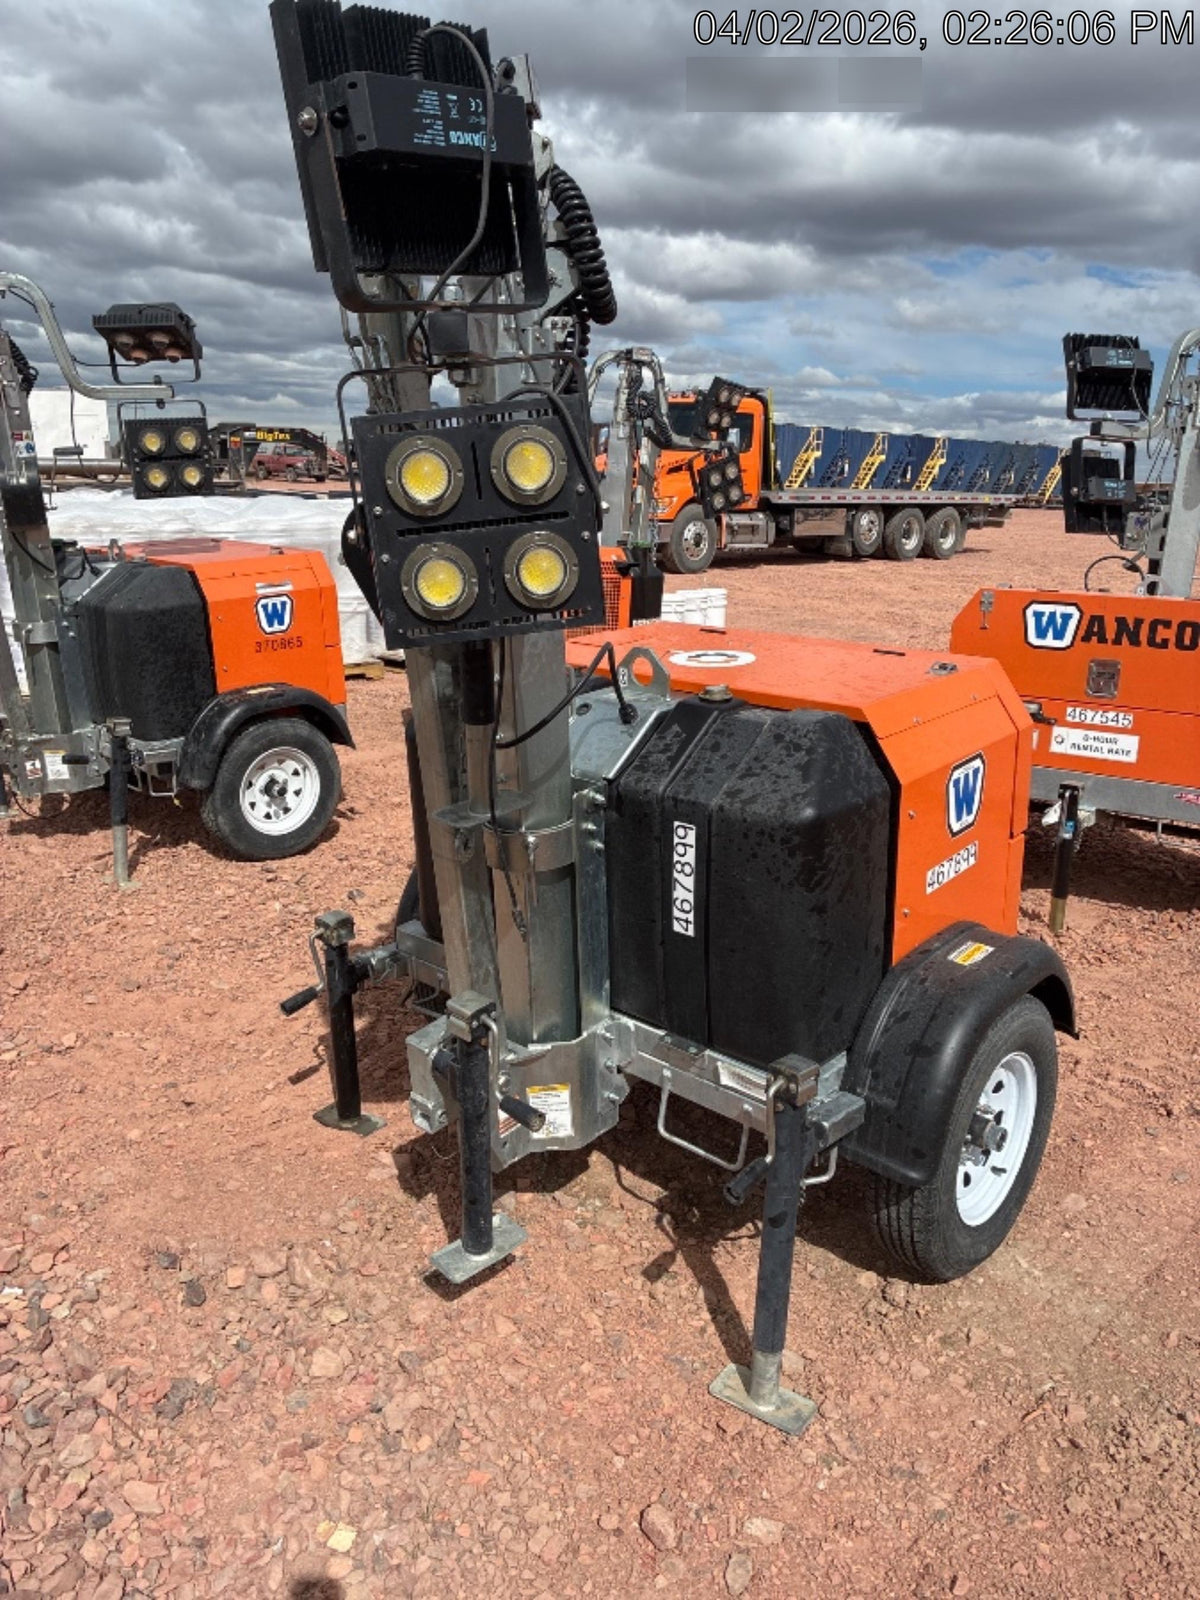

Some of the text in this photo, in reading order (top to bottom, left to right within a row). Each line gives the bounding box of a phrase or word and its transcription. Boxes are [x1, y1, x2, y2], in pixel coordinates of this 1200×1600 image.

[261, 600, 288, 629] W
[1031, 609, 1200, 651] WANCO
[1066, 707, 1133, 728] 467545
[1070, 742, 1132, 757] RENTAL RATE
[952, 765, 981, 824] W
[673, 824, 695, 932] 467899
[927, 843, 978, 889] 467899
